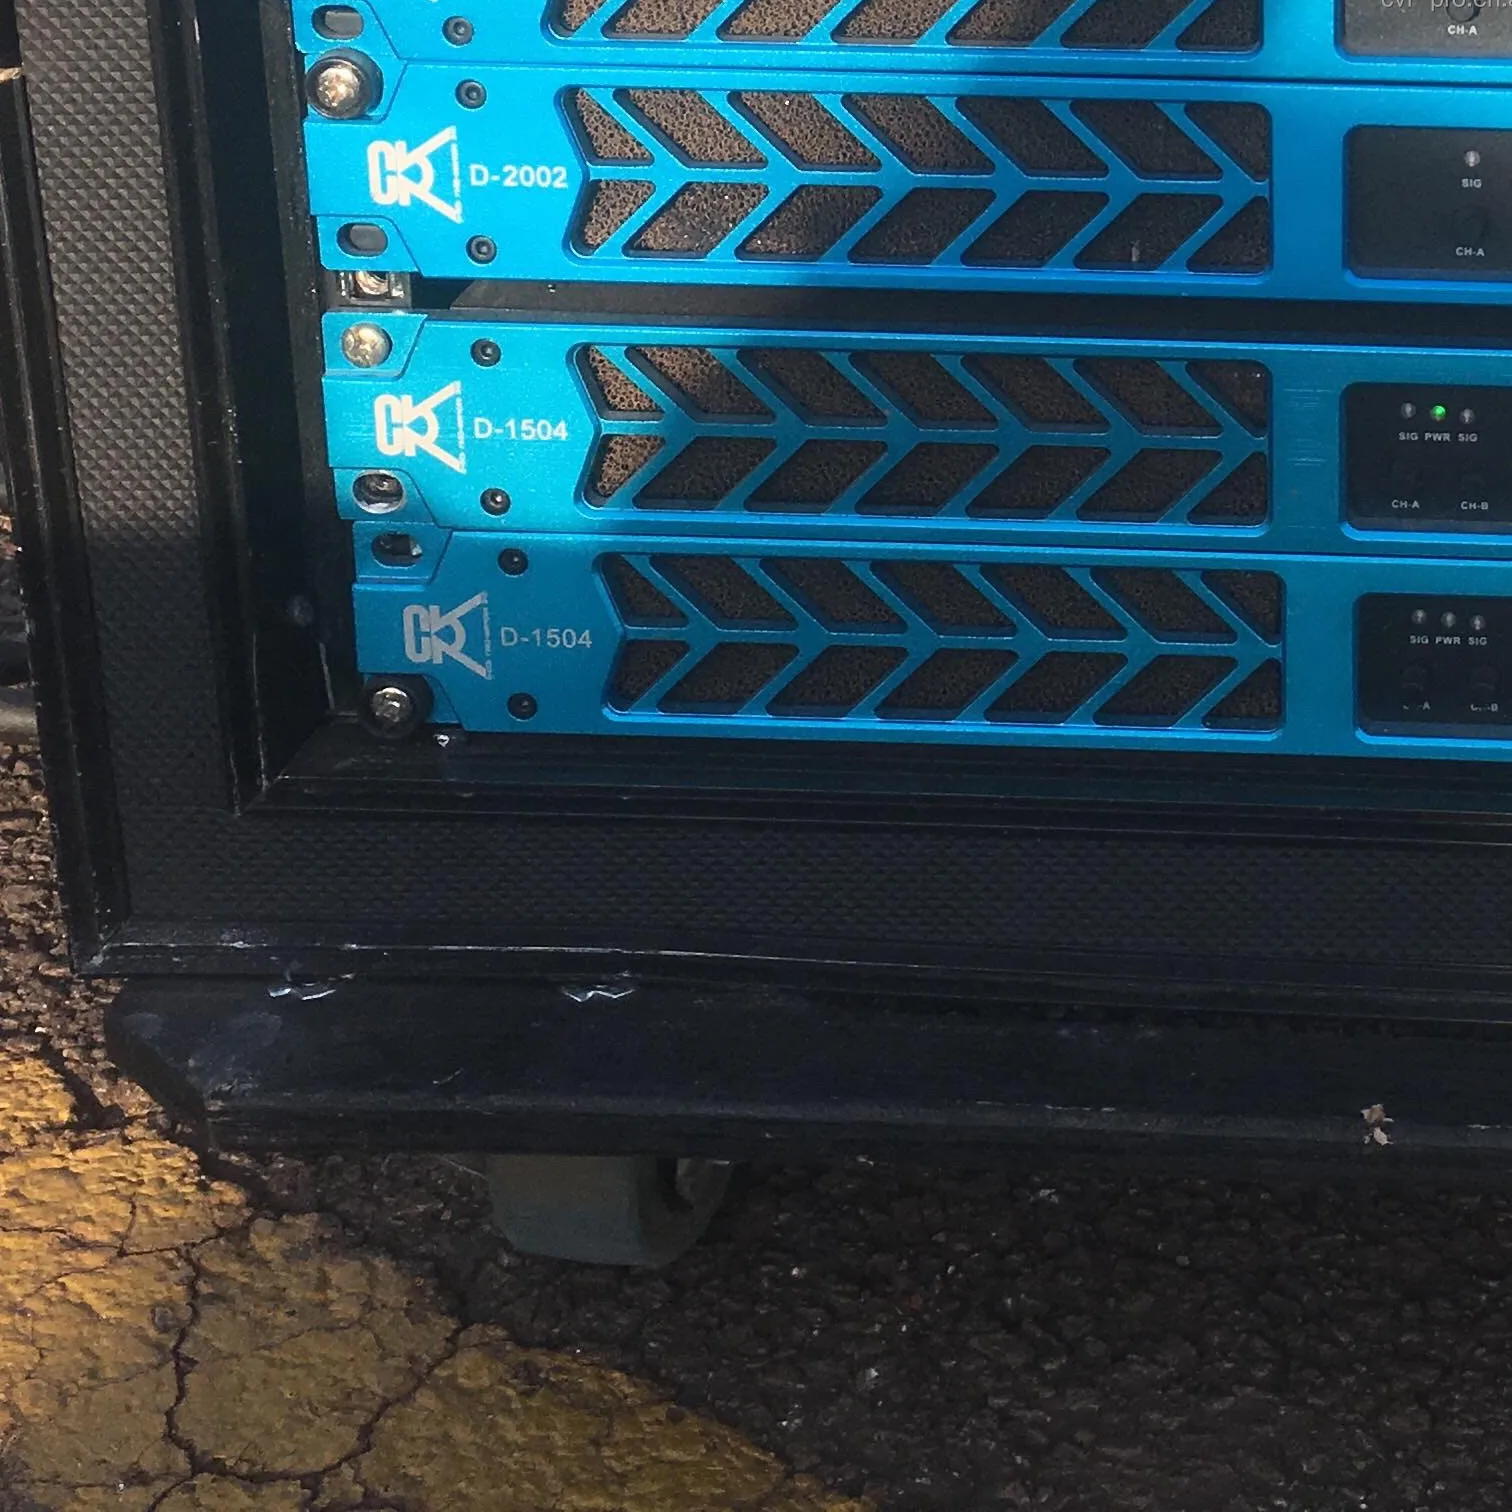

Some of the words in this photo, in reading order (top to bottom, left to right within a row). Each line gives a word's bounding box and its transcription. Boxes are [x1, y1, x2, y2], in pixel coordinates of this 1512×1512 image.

[1447, 25, 1478, 36] CH-A
[469, 164, 568, 189] D-2002
[1461, 178, 1482, 189] SIG
[473, 417, 568, 441] D-1504
[1399, 431, 1418, 441] SIG
[1424, 432, 1451, 442] PWR
[1458, 433, 1478, 442] SIG
[500, 626, 593, 649] D-1504
[1410, 635, 1429, 645] SIG
[1435, 636, 1461, 645] PWR
[1468, 636, 1488, 646] SIG
